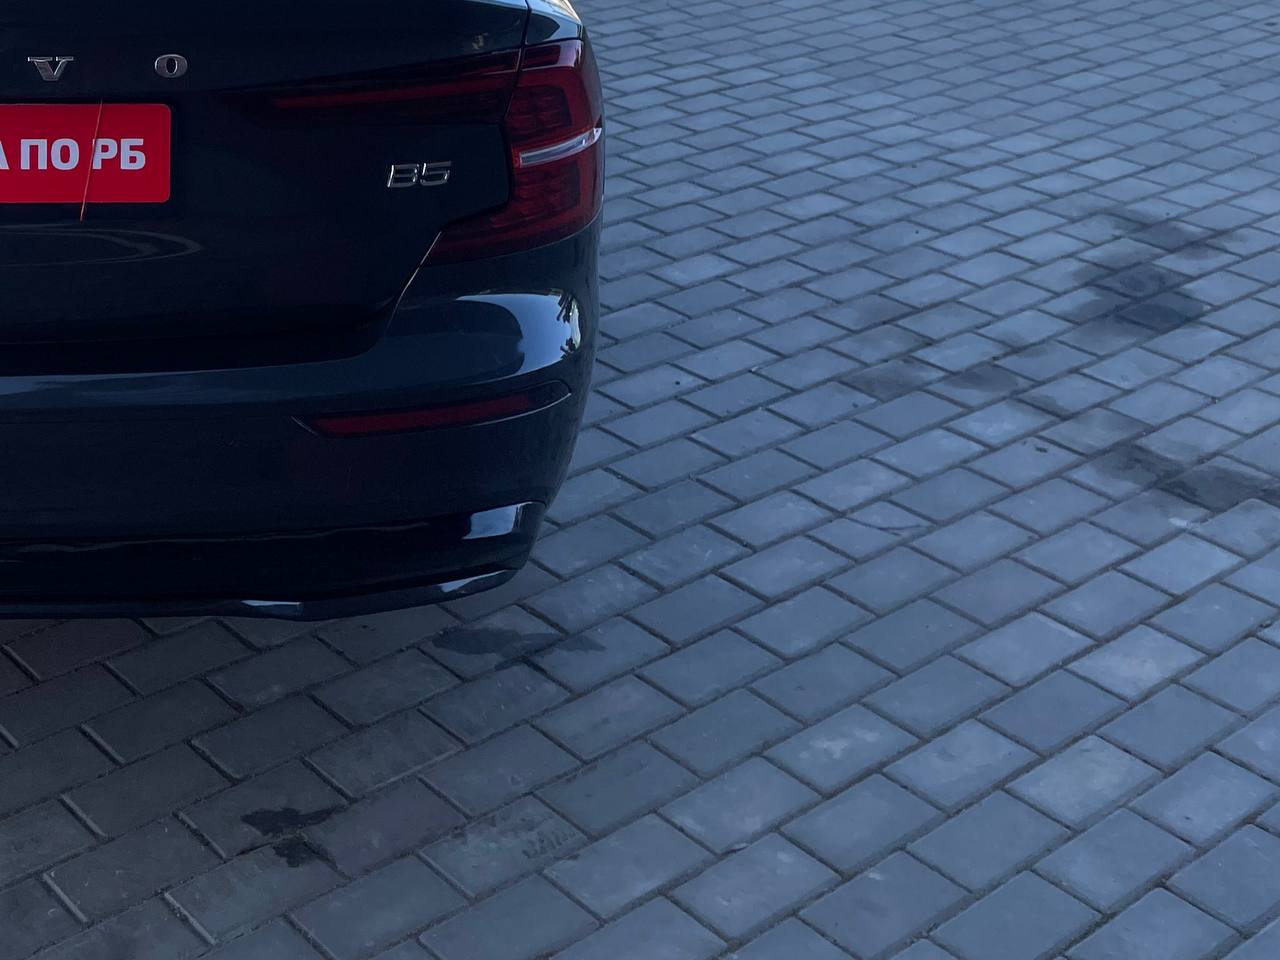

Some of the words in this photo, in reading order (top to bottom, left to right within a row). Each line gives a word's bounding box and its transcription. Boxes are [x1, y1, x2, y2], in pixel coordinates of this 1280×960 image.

[19, 139, 80, 171] ПО
[93, 138, 147, 171] РБ
[387, 161, 451, 188] B5
